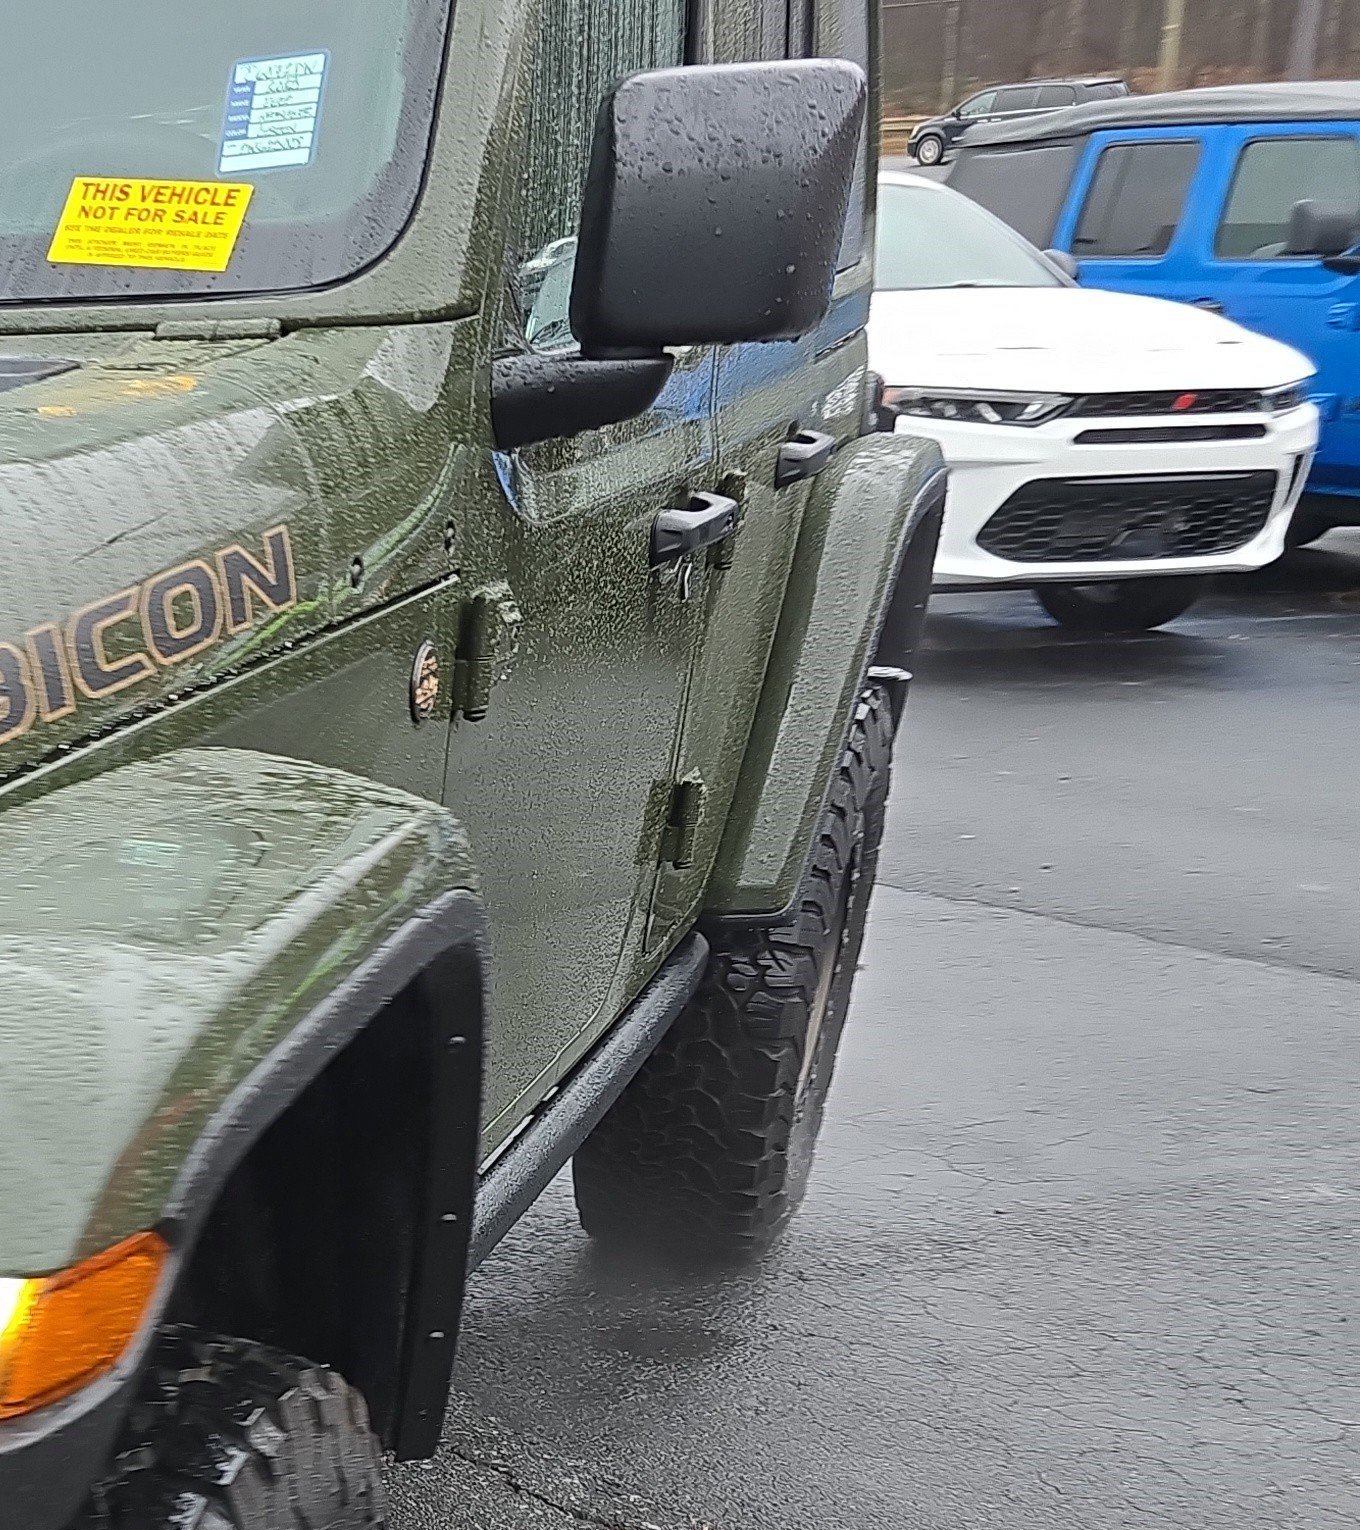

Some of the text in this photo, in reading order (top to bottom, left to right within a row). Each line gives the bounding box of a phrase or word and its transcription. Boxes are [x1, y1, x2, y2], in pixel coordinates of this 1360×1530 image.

[81, 182, 241, 208] THIS VEHICLE
[78, 205, 229, 226] NOT FOR SALE
